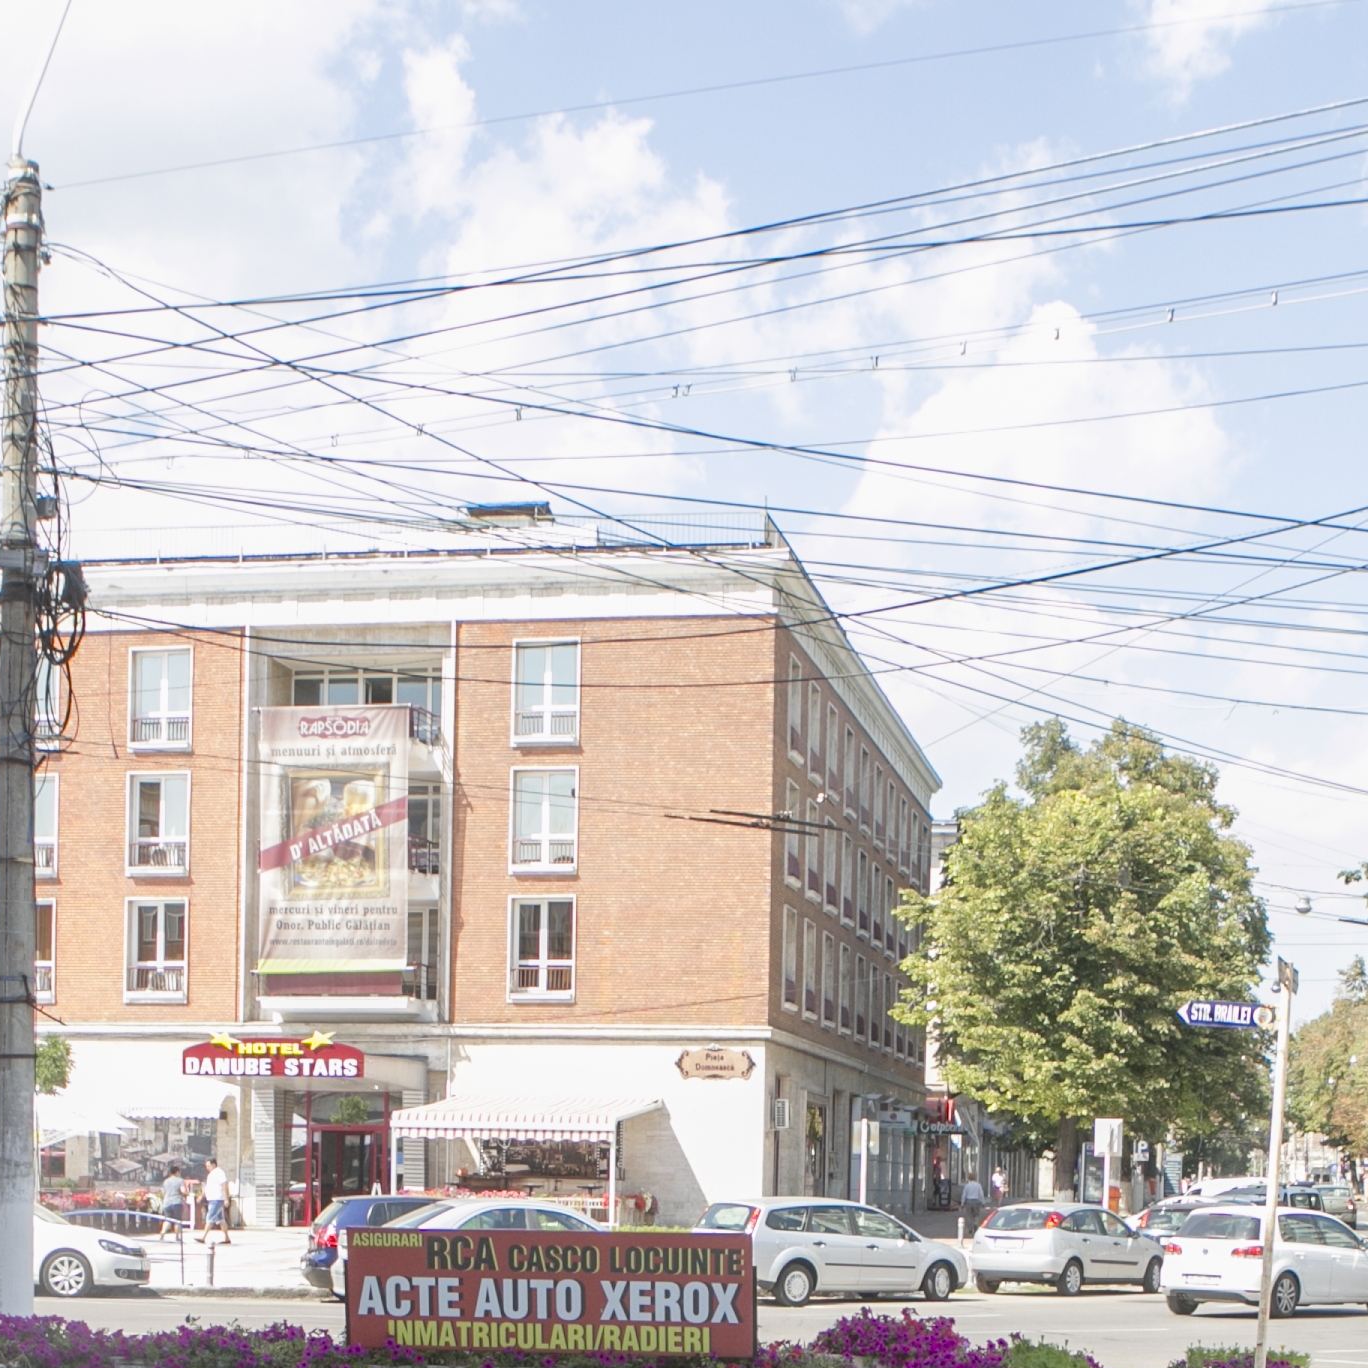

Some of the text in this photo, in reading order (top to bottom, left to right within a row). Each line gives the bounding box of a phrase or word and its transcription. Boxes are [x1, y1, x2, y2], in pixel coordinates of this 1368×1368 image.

[300, 720, 370, 735] RAPSODIA
[308, 809, 382, 854] ALTĂDATĂ
[269, 904, 310, 915] mercuri
[328, 904, 359, 915] vineri
[363, 905, 398, 917] pentru
[276, 919, 304, 931] Onor.
[307, 919, 341, 931] Public
[1191, 1003, 1212, 1022] STR.
[237, 1042, 304, 1055] HOTEL
[185, 1057, 358, 1077] DANUBE STARS
[1138, 1140, 1148, 1153] P
[352, 1232, 745, 1277] ASIGURARI RCA CASCO LOCUINTE
[358, 1275, 743, 1325] ACTE AUTO XEROX
